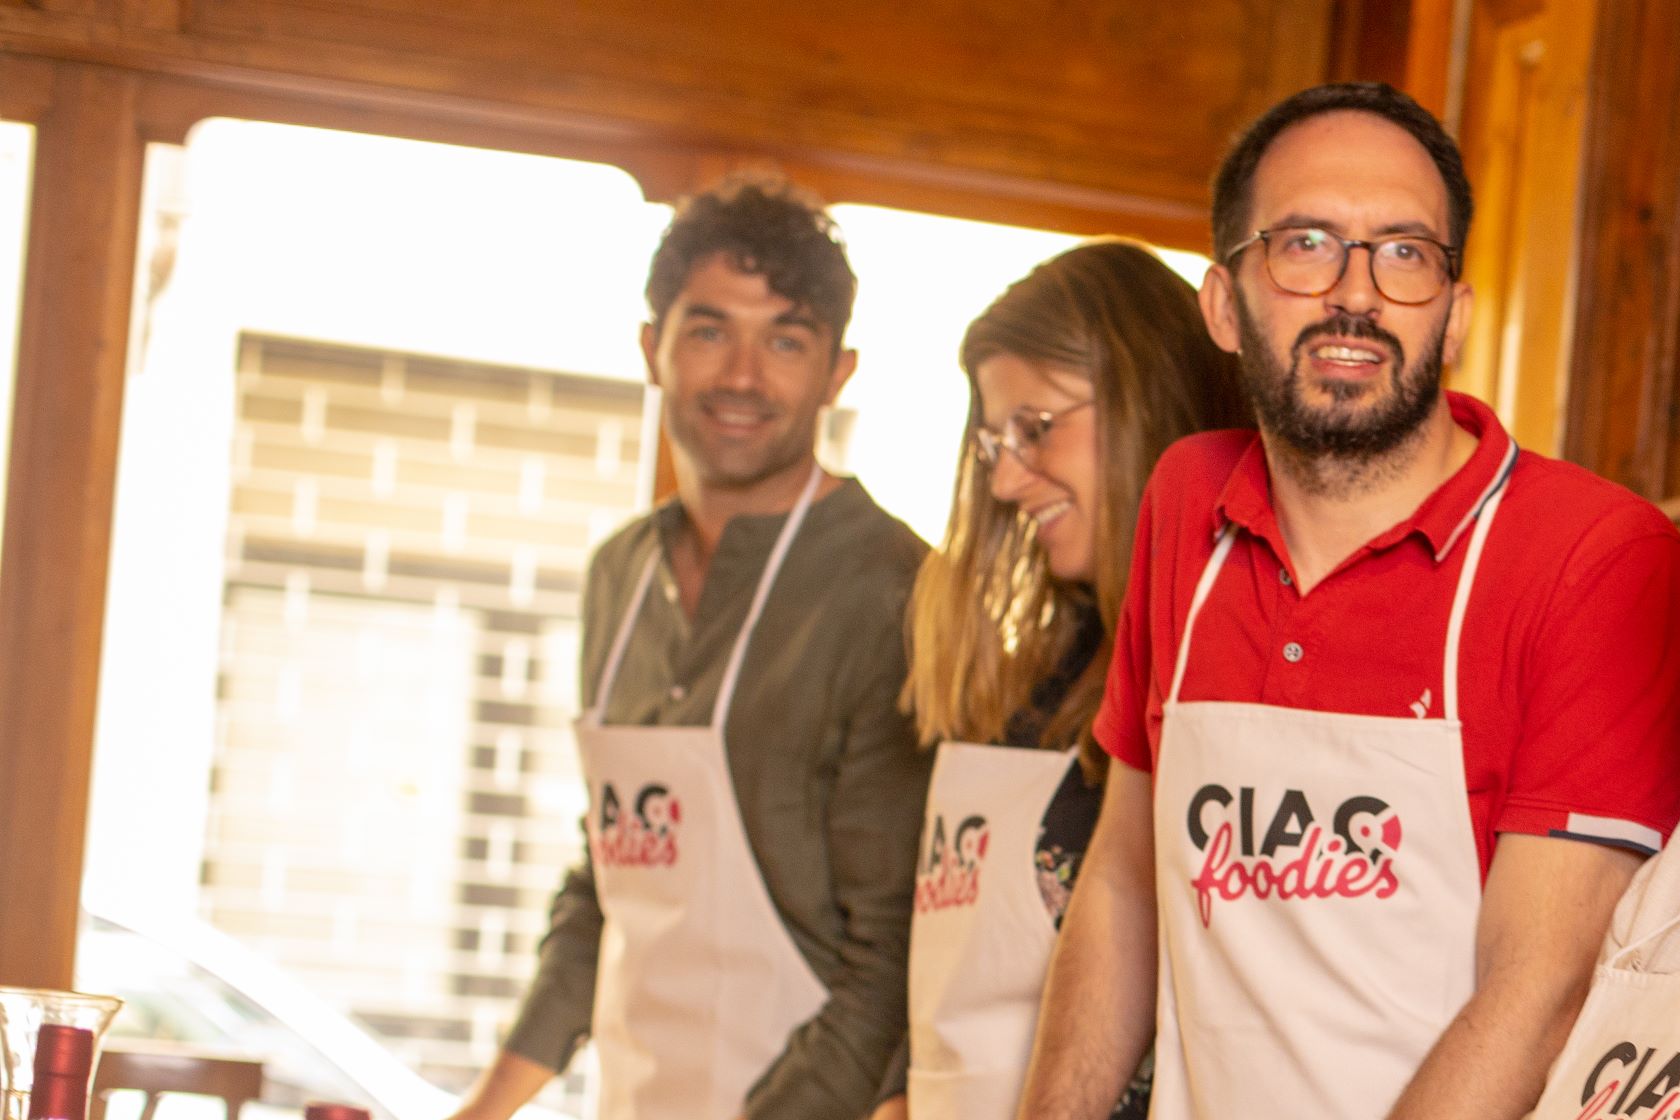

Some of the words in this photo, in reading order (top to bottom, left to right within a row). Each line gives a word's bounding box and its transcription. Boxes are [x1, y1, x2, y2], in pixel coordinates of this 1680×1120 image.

[600, 781, 681, 837] AO
[1187, 784, 1402, 866] CIAO
[1191, 821, 1399, 929] foodies
